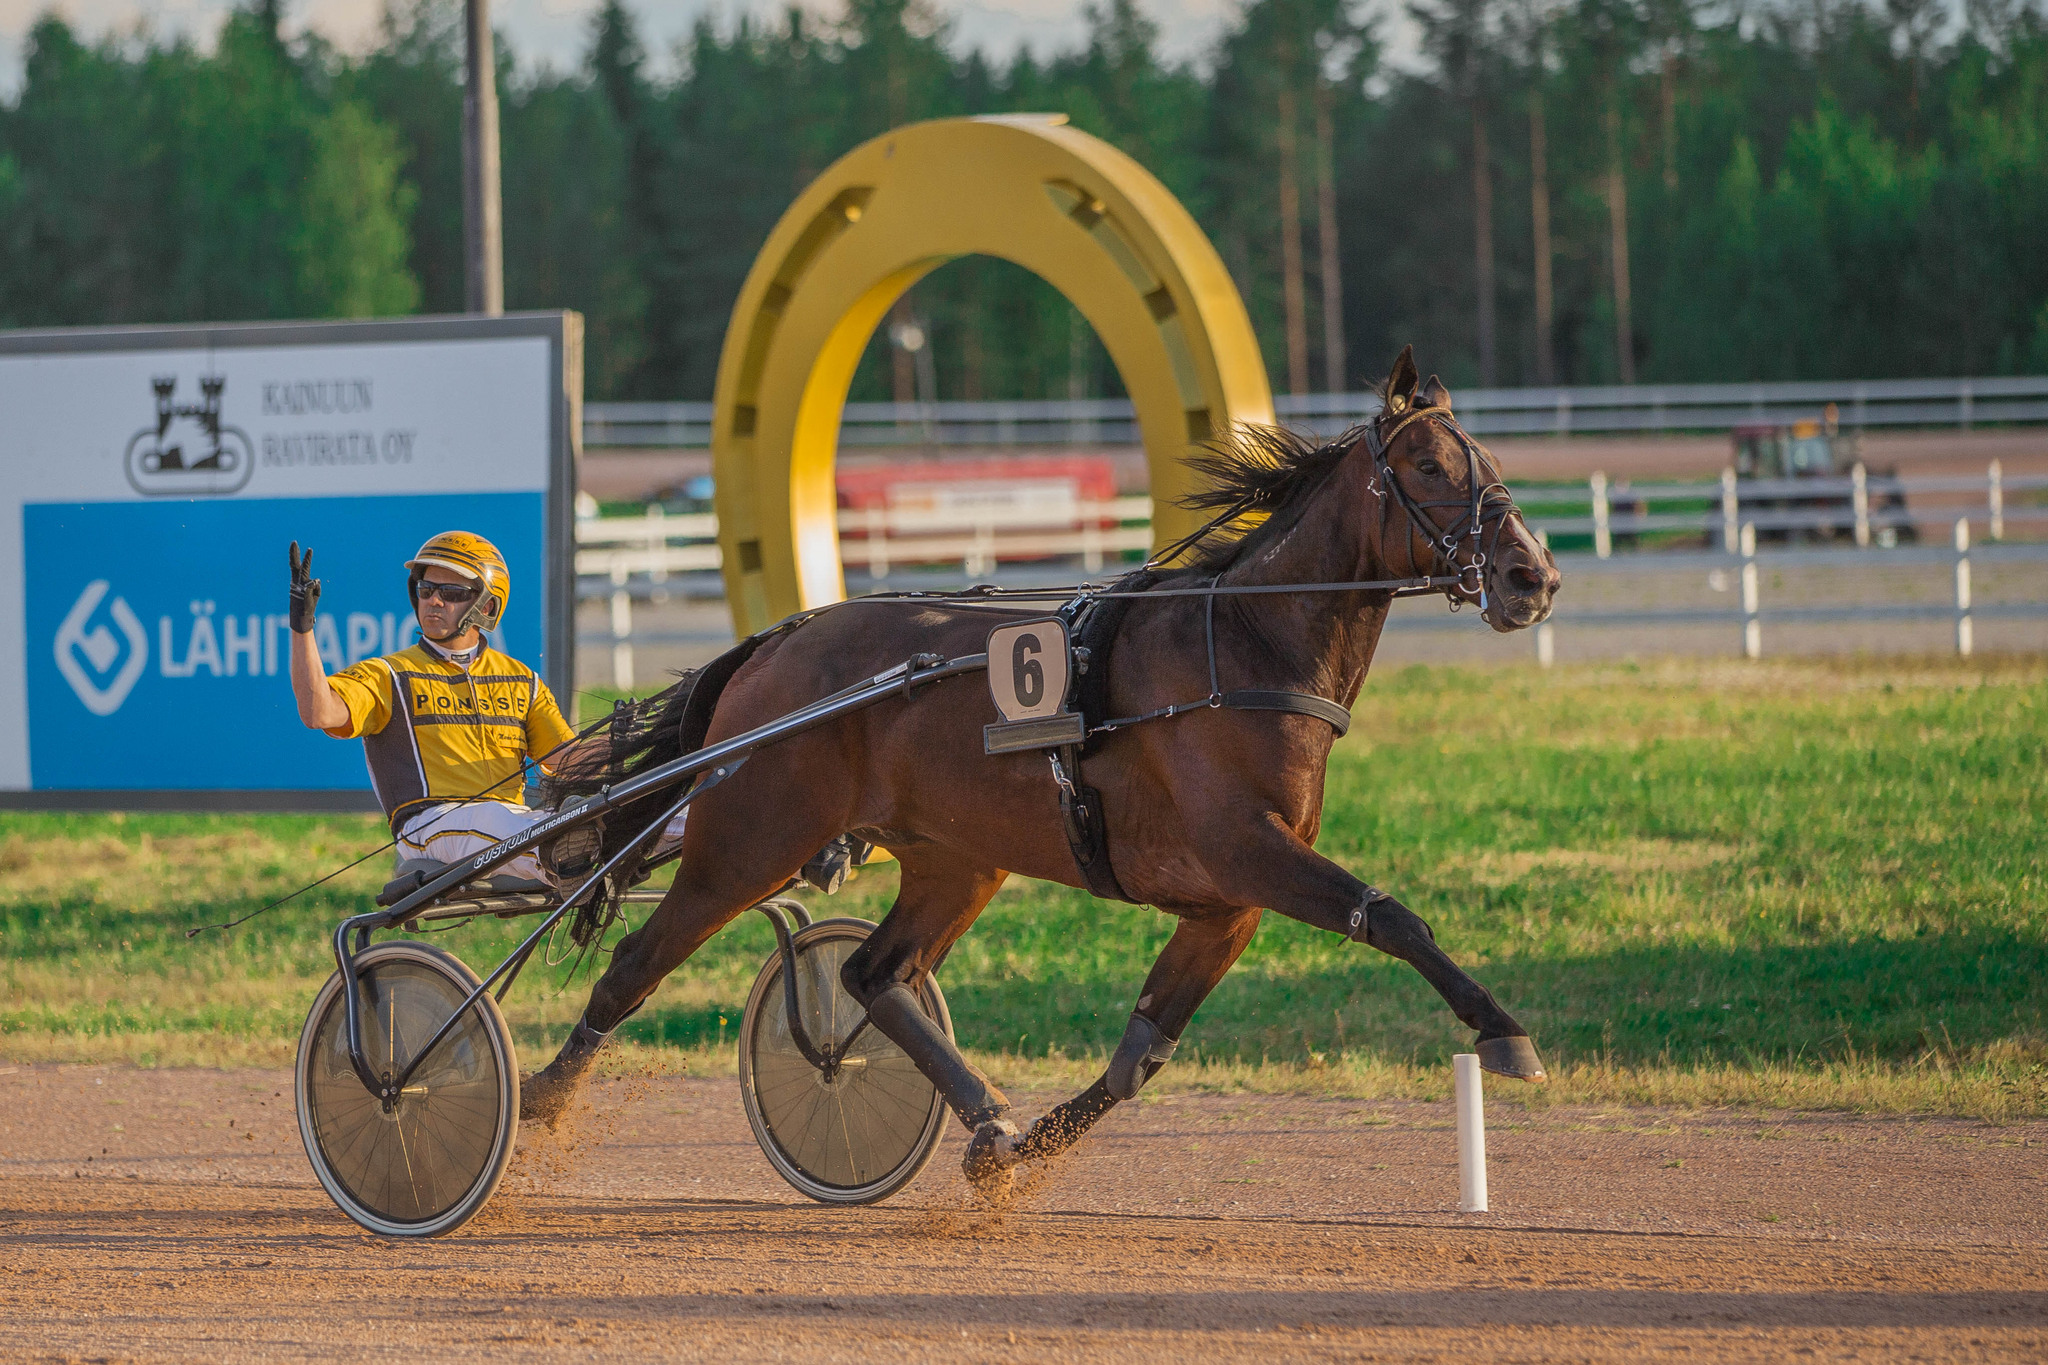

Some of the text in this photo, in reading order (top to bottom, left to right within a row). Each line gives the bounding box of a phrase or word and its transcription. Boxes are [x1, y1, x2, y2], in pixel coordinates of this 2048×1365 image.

[261, 377, 373, 416] KAINUUN
[261, 427, 417, 467] RAVIRATA OY
[1012, 633, 1045, 707] 6
[416, 694, 526, 713] PONSSE
[530, 806, 582, 838] MULTICARBON
